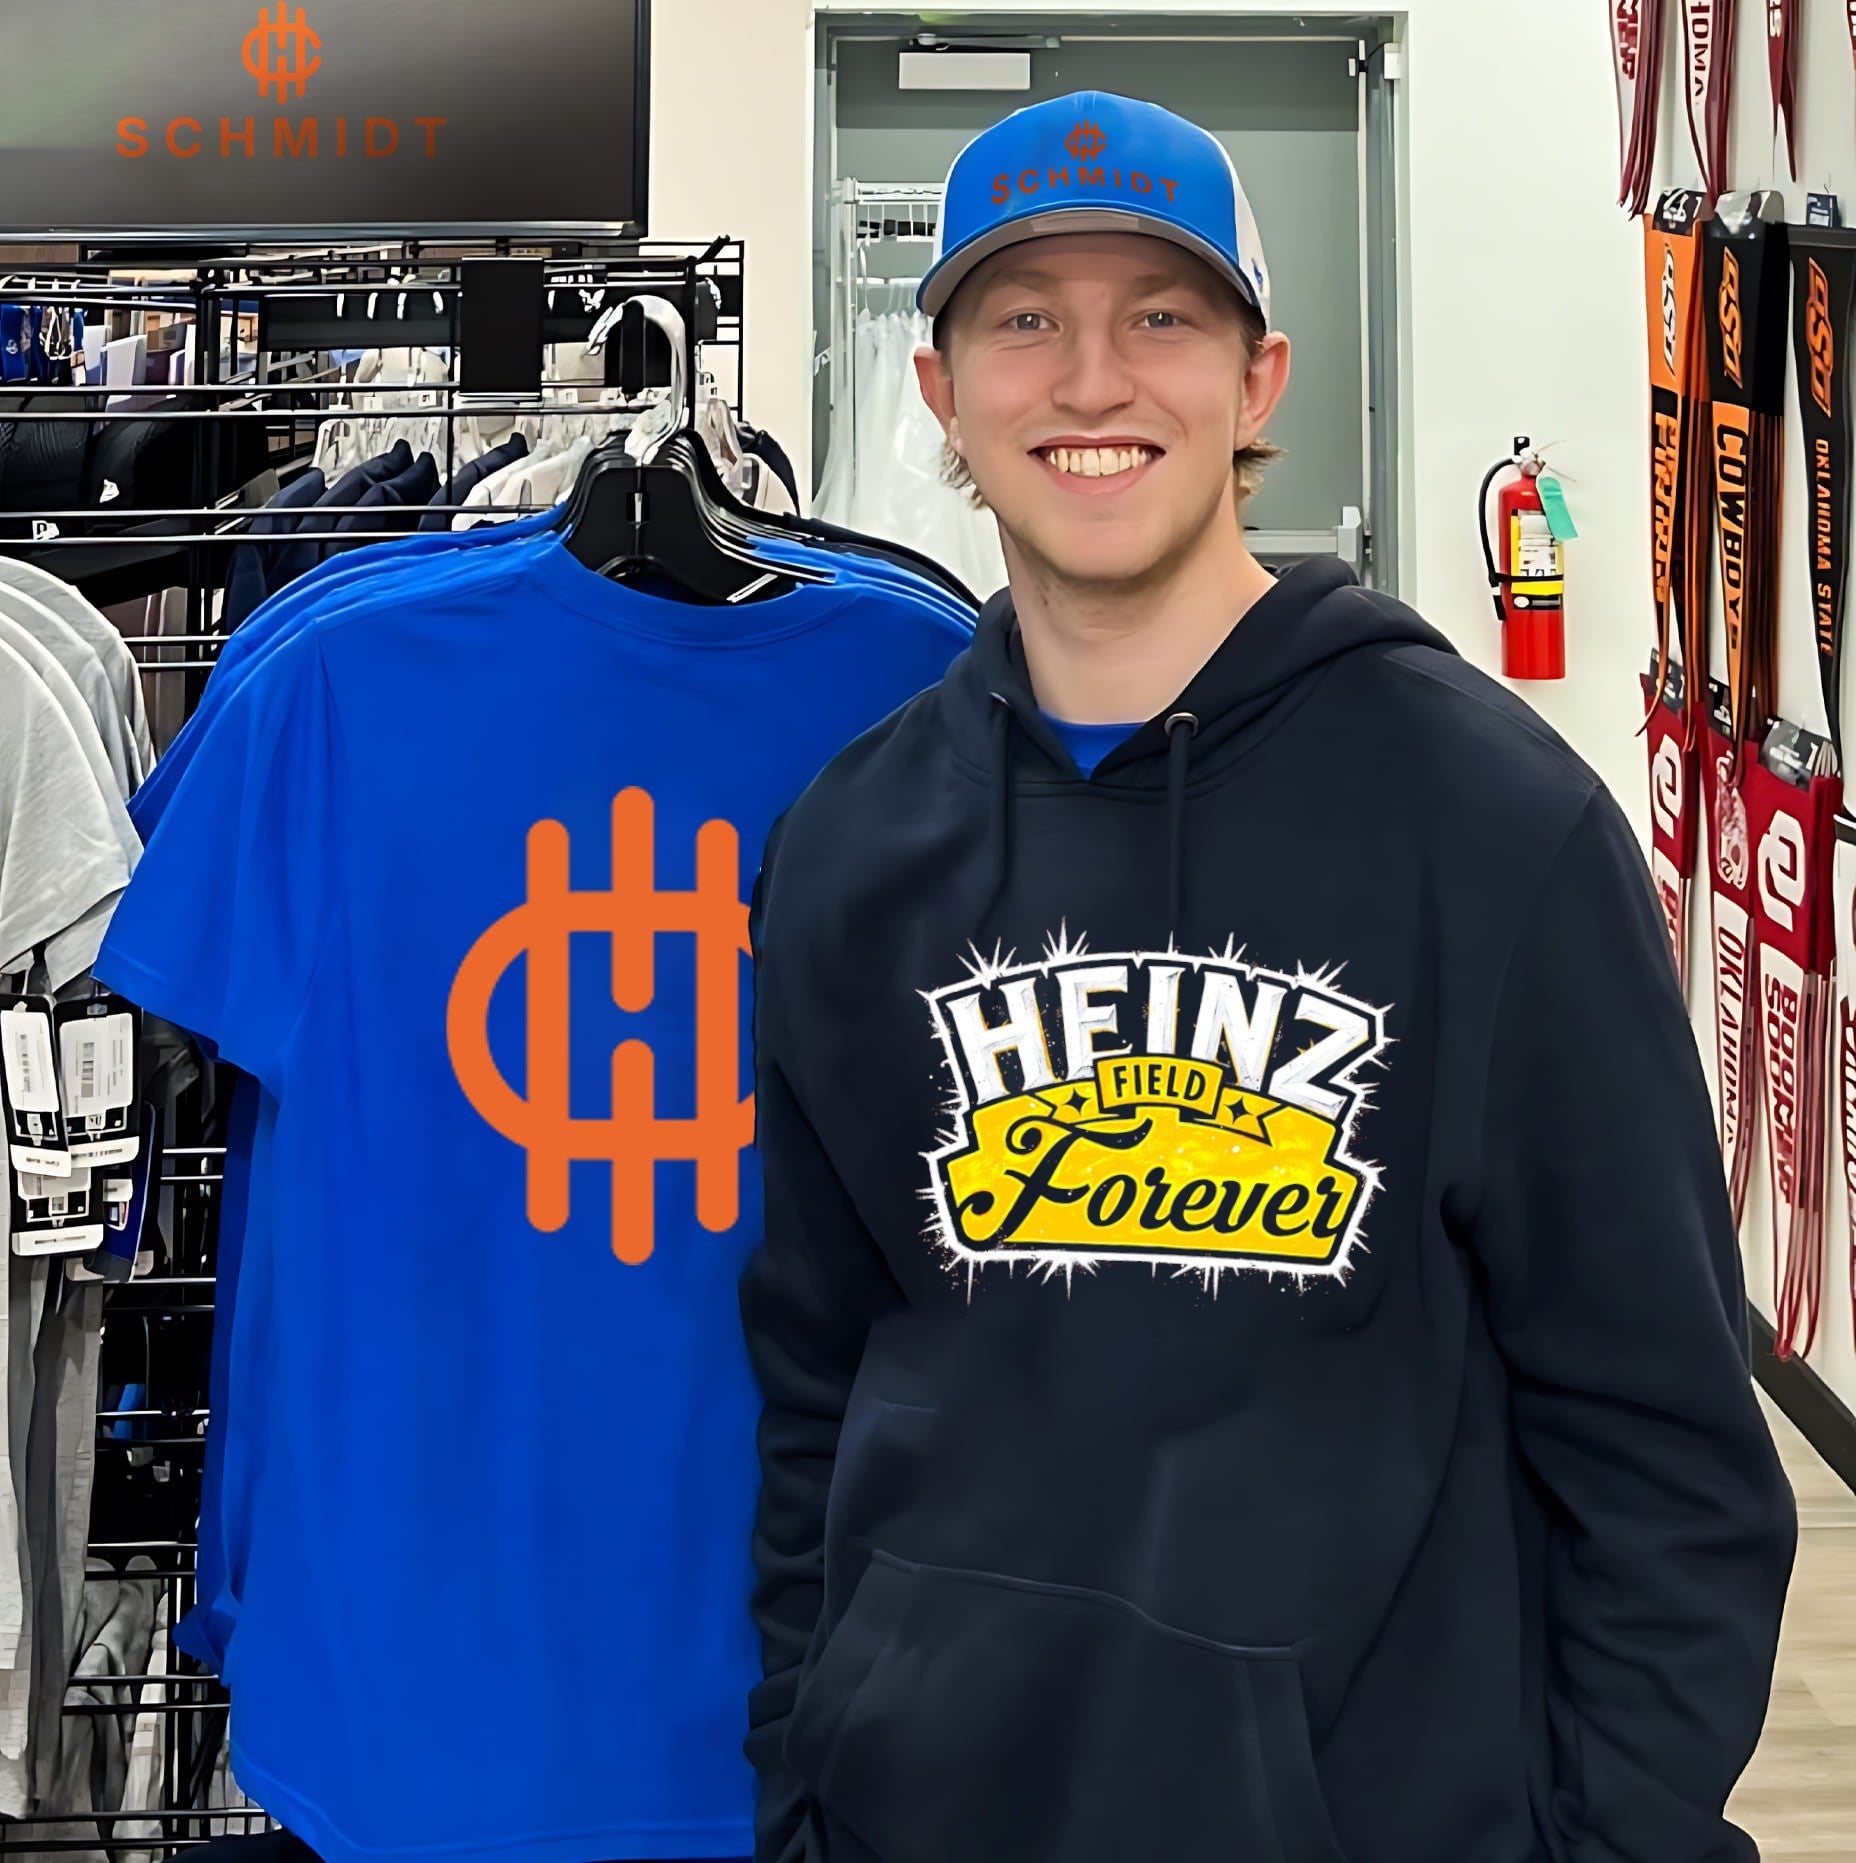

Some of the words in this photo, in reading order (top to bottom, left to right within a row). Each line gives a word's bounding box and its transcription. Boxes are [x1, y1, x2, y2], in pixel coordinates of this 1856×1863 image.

[115, 116, 448, 158] SCHMIDT
[991, 167, 1179, 205] SCHMIDT
[1815, 438, 1833, 570] OKLAHOMA
[946, 964, 1370, 1121] HEINZ
[1112, 1063, 1207, 1102] FIELD
[958, 1114, 1344, 1241] Forever
